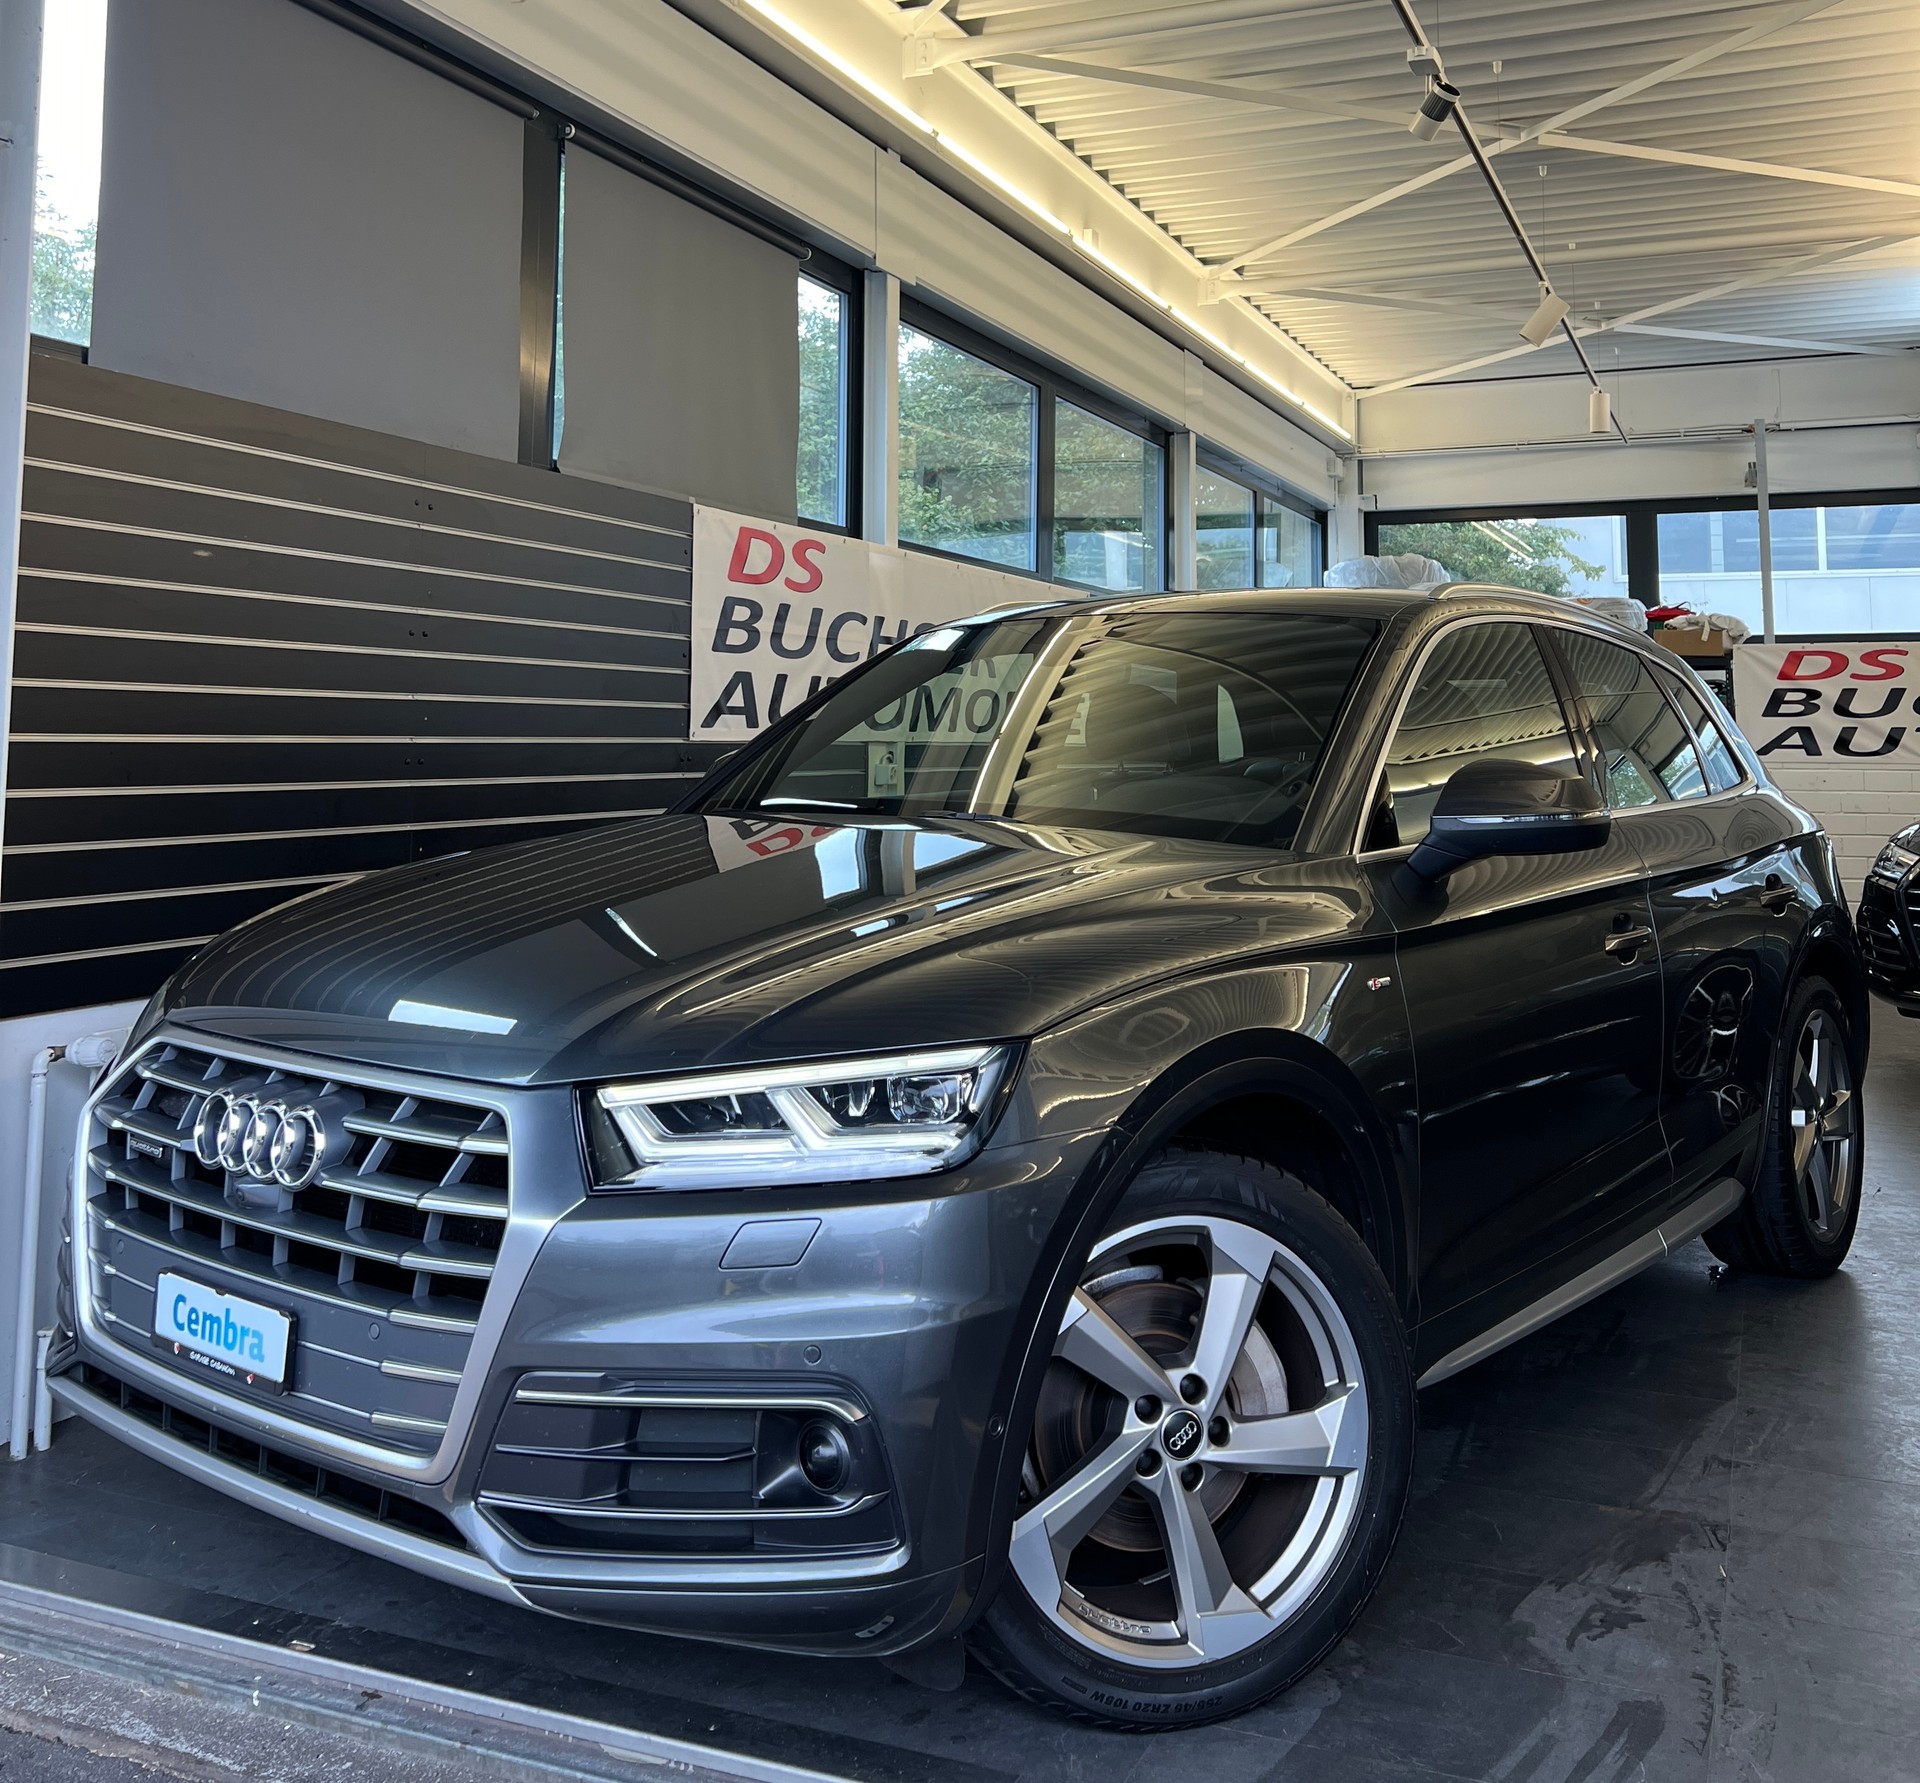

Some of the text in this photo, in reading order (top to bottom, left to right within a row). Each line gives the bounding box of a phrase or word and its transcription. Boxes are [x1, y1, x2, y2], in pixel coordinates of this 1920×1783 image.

[727, 526, 826, 593] DS
[711, 596, 997, 678] BUCH
[1776, 649, 1909, 681] DS
[1761, 688, 1920, 718] BU
[1757, 726, 1920, 757] AU
[172, 1293, 265, 1363] Cembra
[1079, 1603, 1152, 1634] quattro
[1132, 1702, 1170, 1714] ZR20
